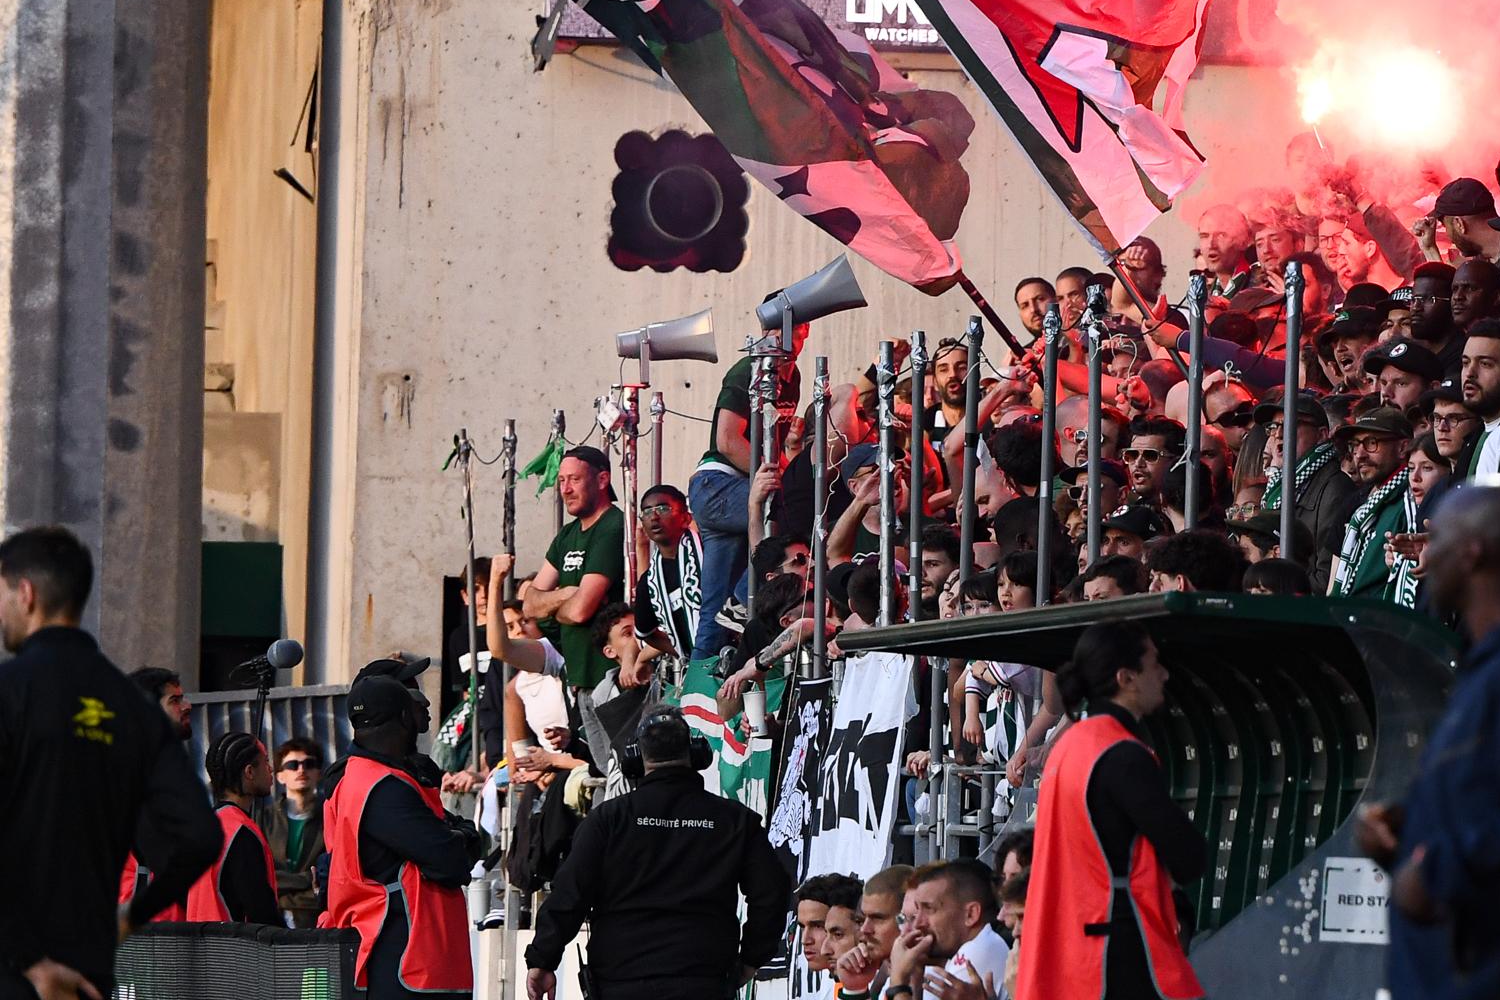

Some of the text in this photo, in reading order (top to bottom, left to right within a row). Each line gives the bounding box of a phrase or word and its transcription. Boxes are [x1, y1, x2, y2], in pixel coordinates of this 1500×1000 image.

[864, 27, 939, 43] WATCHES
[636, 816, 715, 829] SÉCURITÉ PRIVÉE
[1338, 894, 1364, 906] RED
